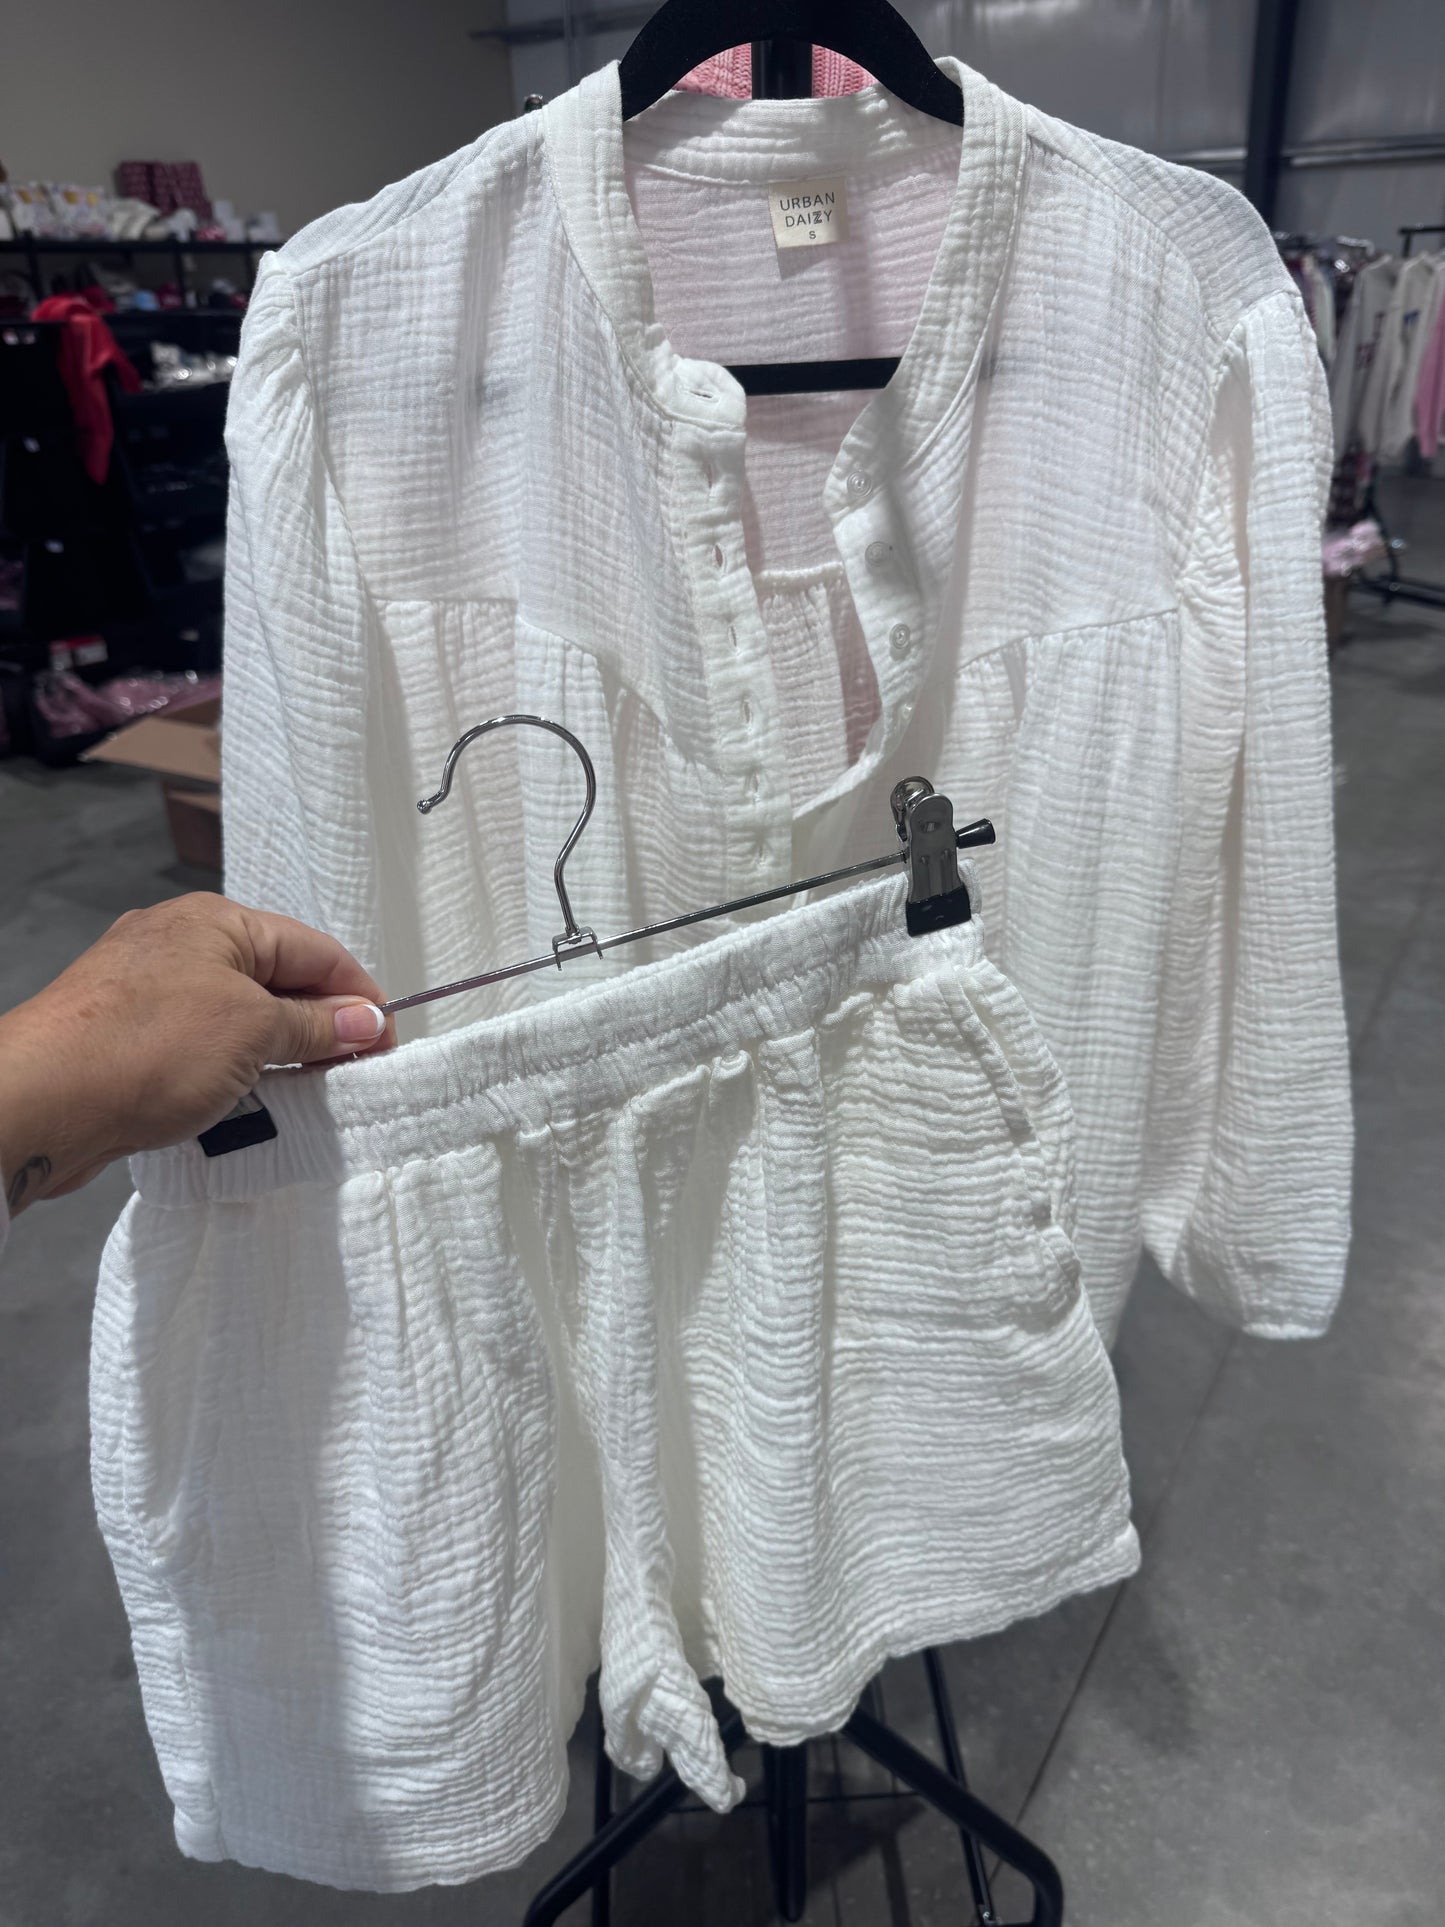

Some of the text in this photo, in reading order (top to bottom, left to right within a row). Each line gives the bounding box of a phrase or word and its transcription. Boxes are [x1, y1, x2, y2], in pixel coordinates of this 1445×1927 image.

[779, 191, 836, 212] URBAN
[785, 210, 833, 228] DAIZY
[808, 230, 817, 240] S
